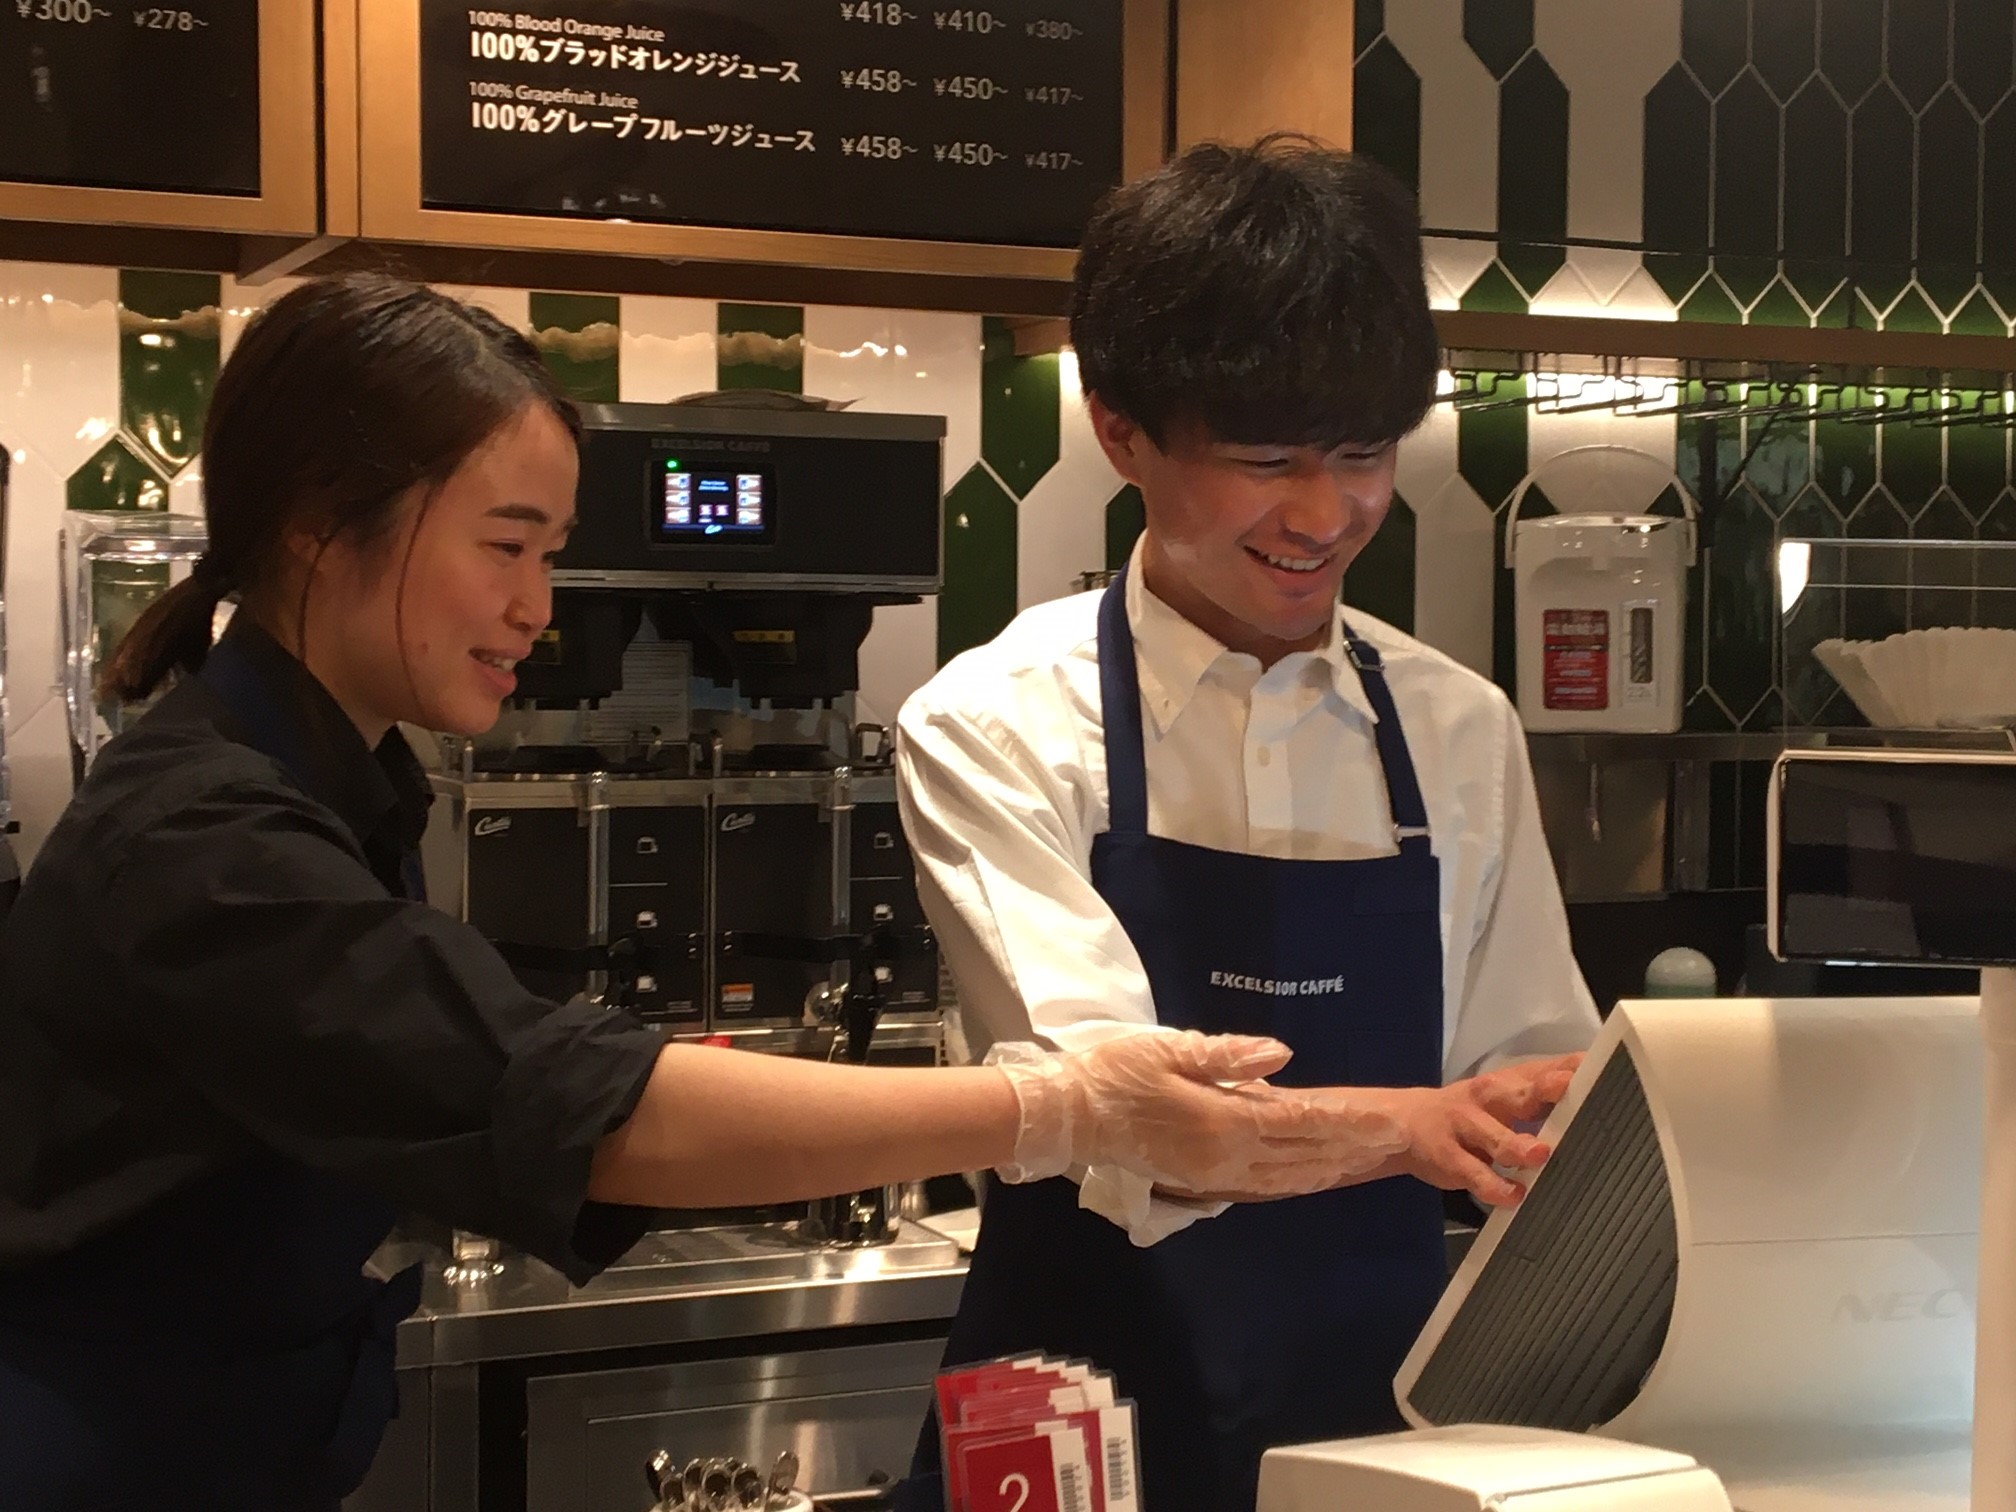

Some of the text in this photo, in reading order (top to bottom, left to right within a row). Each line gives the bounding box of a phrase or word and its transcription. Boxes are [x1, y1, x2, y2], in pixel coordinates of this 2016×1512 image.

[469, 11, 665, 42] 100% Blood Orange Juice
[471, 31, 801, 82] 100%ブラッドオレンジジュース
[469, 81, 640, 109] 100% Grapefruit Juice
[472, 102, 816, 152] 100%グレープフルーツジュース
[1210, 971, 1345, 996] EXCELSIOR CAFFÉ
[1831, 1288, 1965, 1324] NEC
[999, 1472, 1029, 1512] 2
